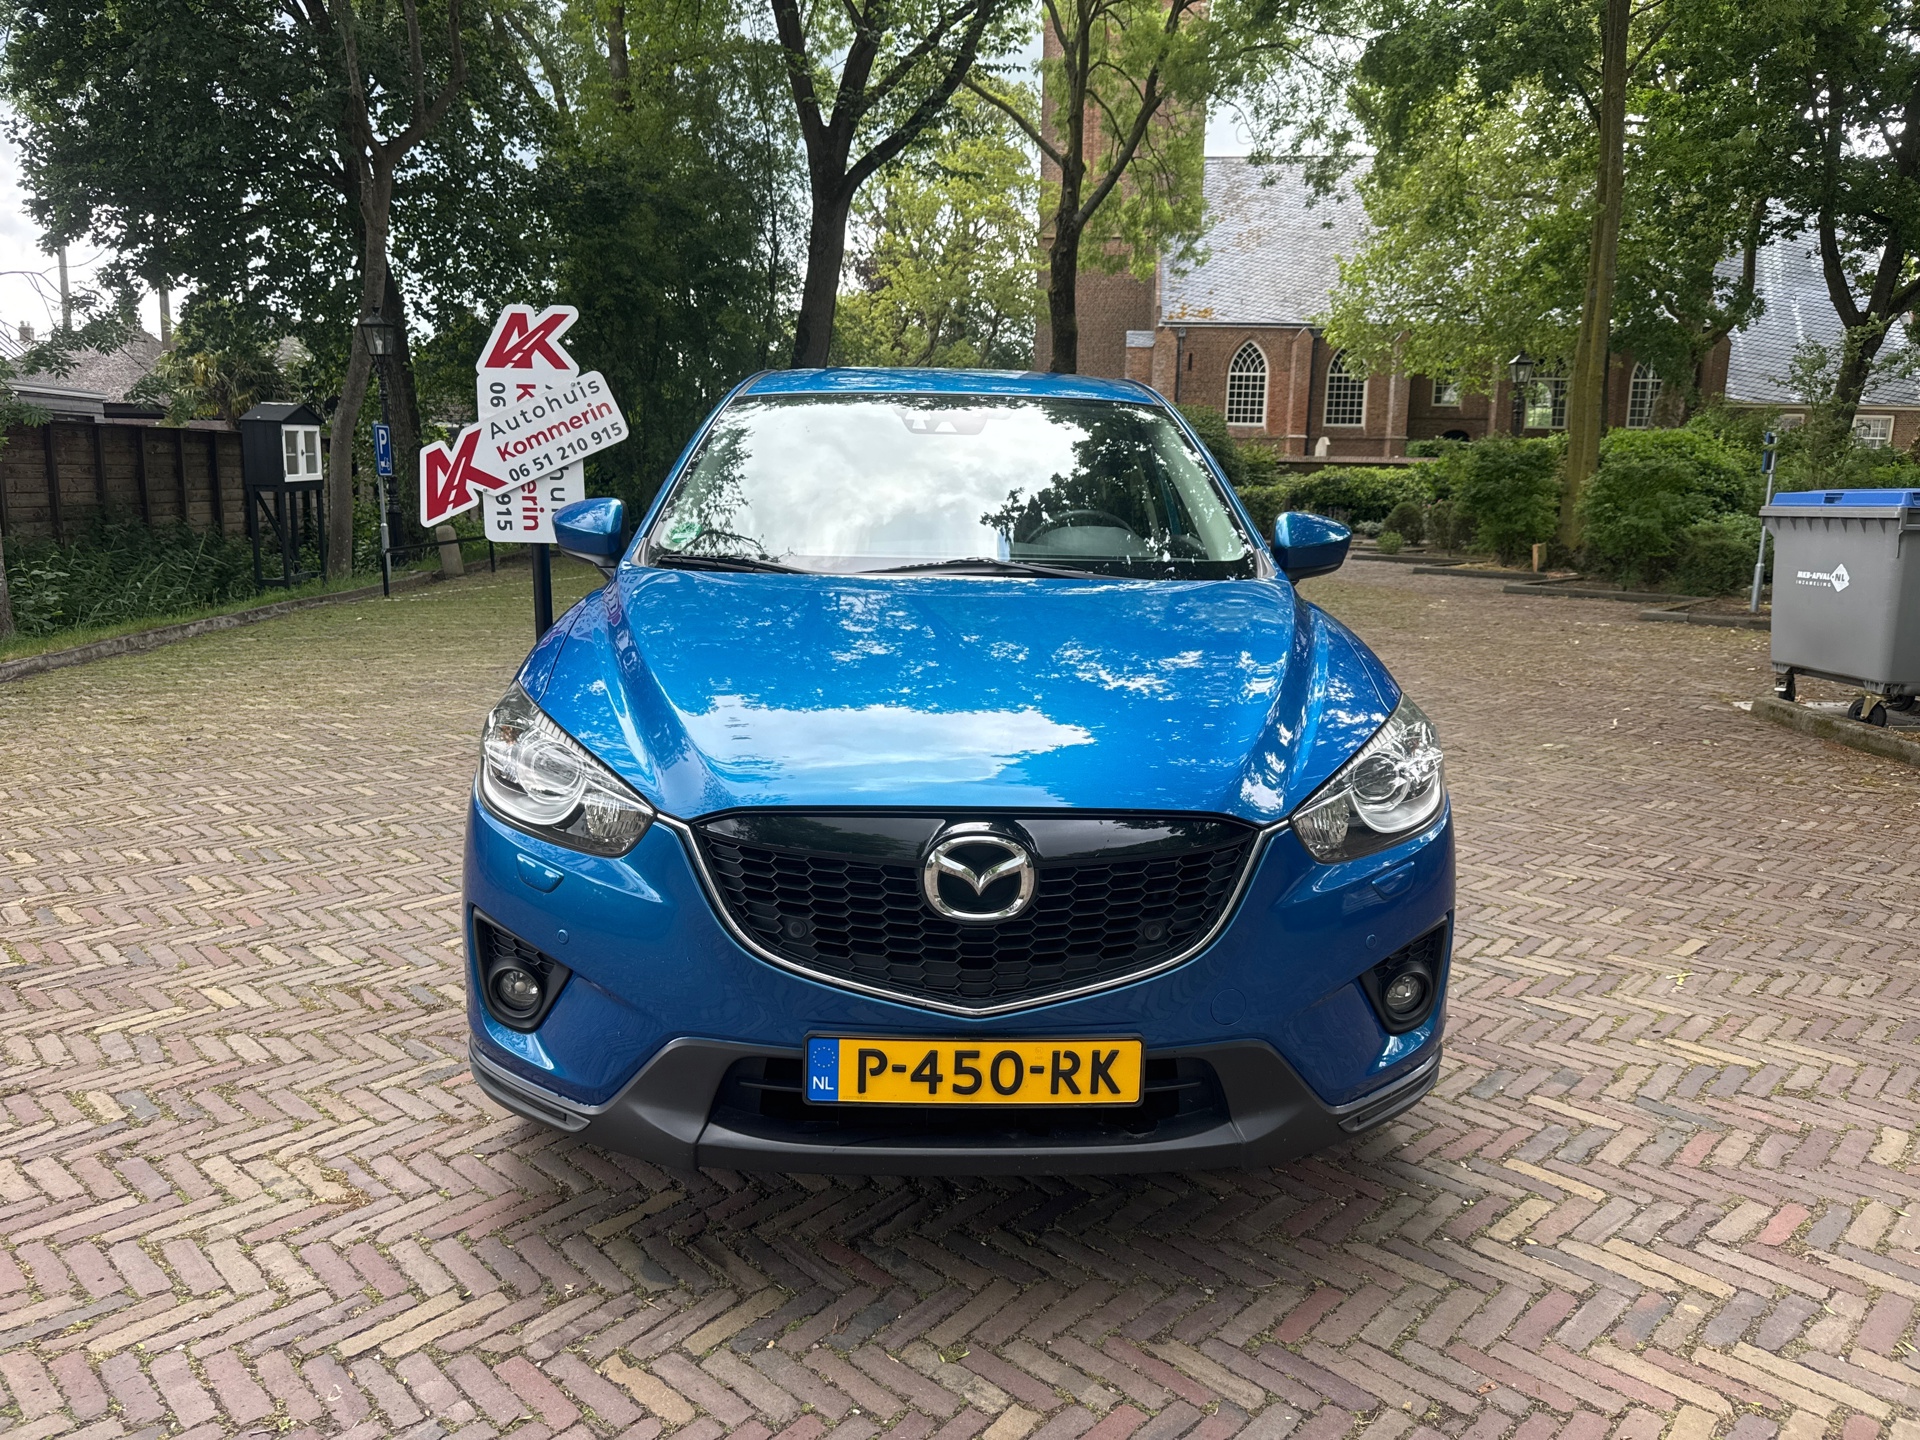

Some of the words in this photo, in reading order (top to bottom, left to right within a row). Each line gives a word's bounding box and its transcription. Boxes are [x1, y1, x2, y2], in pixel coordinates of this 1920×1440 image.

[490, 382, 506, 407] 06
[490, 380, 600, 439] Autohuis
[378, 429, 387, 454] P
[496, 401, 613, 462] Kommerin
[508, 463, 530, 482] 06
[532, 453, 553, 471] 51
[557, 437, 588, 461] 210
[591, 421, 623, 446] 915
[812, 1076, 834, 1091] NL
[857, 1048, 1121, 1095] P-450-RK
